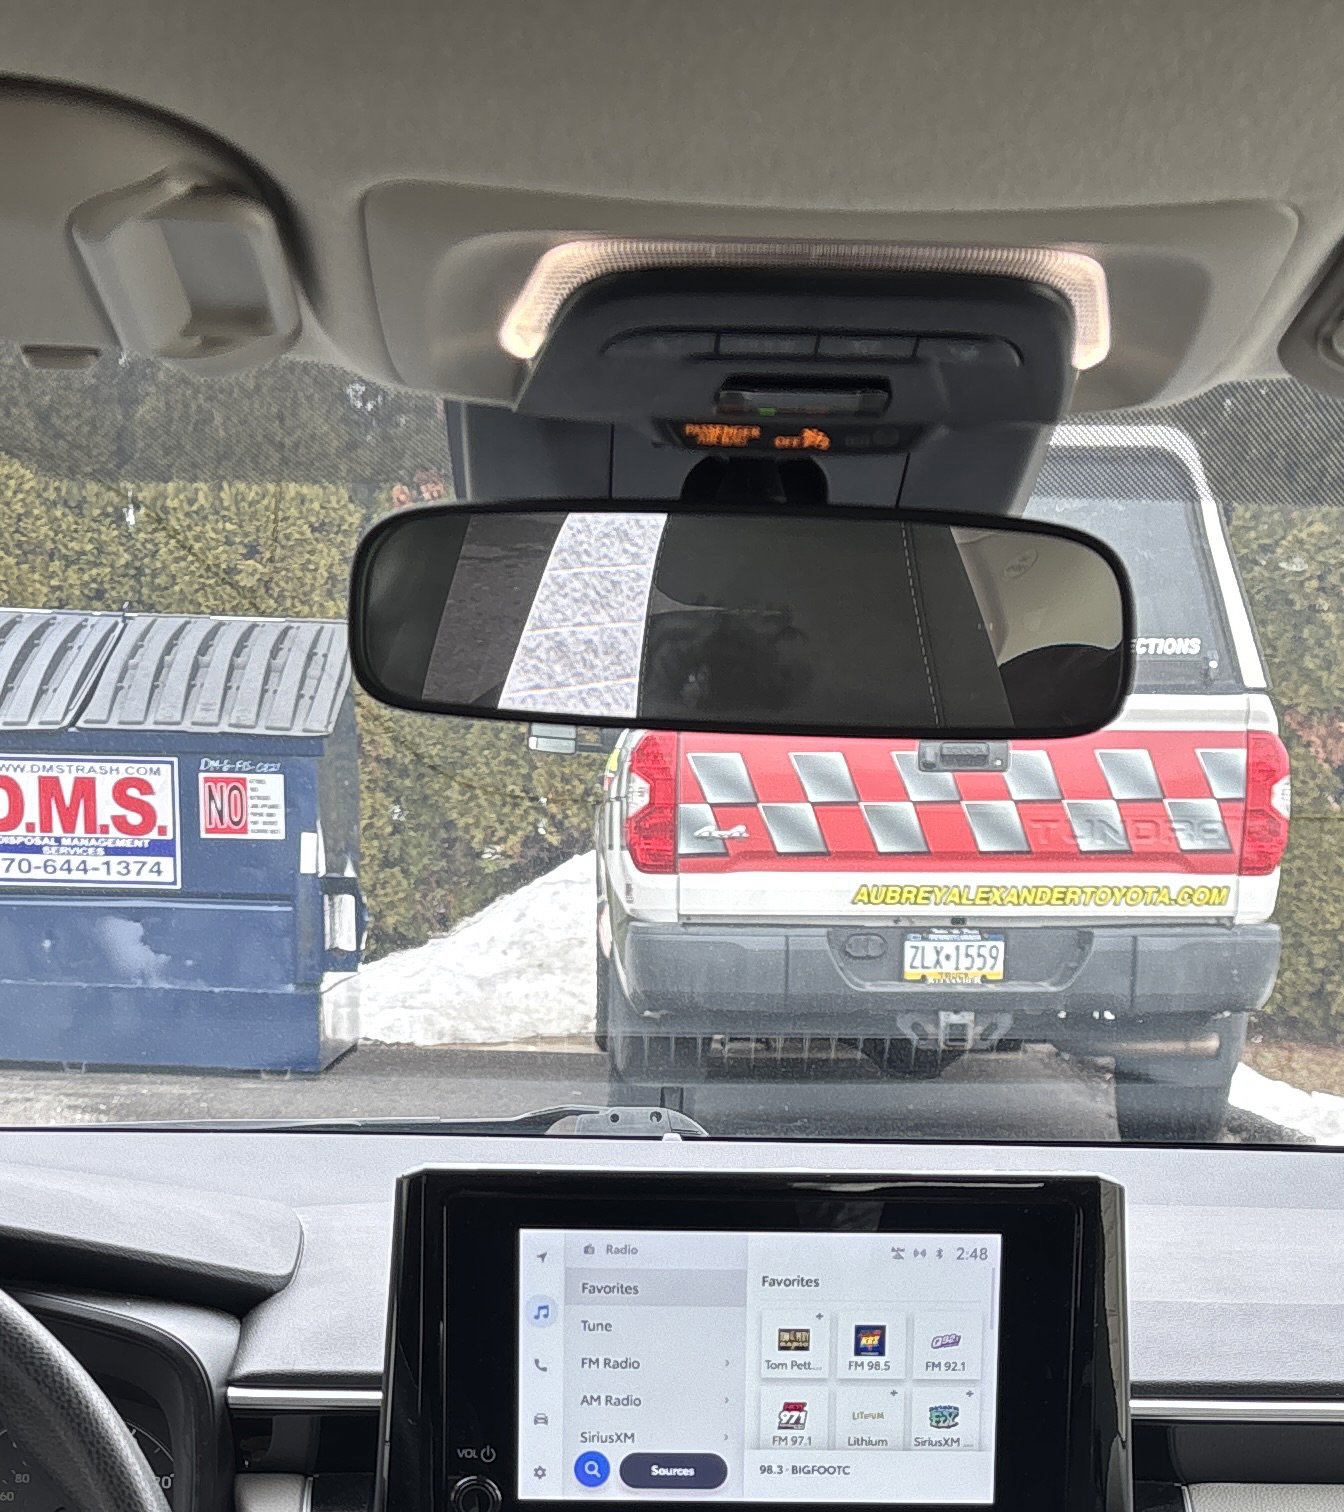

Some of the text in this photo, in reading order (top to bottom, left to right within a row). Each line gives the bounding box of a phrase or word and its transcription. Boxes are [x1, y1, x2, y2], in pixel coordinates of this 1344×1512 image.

[205, 782, 246, 829] NO
[1030, 818, 1227, 846] TUNDRA
[61, 837, 150, 848] MANAGEMENT
[42, 847, 105, 856] SERVICES
[853, 885, 1231, 907] AUBREYALEXANDERTOYOTA.COM
[606, 1244, 639, 1255] Radio
[956, 1247, 988, 1261] 2:48
[761, 1275, 820, 1288] Favorites
[581, 1282, 639, 1295] Favorites
[581, 1320, 612, 1332] Tune
[581, 1357, 641, 1370] FM Radio
[765, 1360, 788, 1371] Tom
[848, 1361, 891, 1371] FM 98.5
[925, 1361, 966, 1372] FM 92.1
[580, 1394, 642, 1407] AM Radio
[580, 1431, 635, 1444] SiriusXM
[772, 1436, 812, 1446] FM 97.1
[848, 1436, 888, 1447] Lithium
[914, 1437, 961, 1447] SiriusXM
[457, 1448, 478, 1458] VOL
[651, 1465, 695, 1477] Sources
[759, 1465, 784, 1475] 98.3
[791, 1465, 851, 1475] BIGFOOTC
[15, 1473, 30, 1484] 80
[0, 1491, 15, 1502] 60
